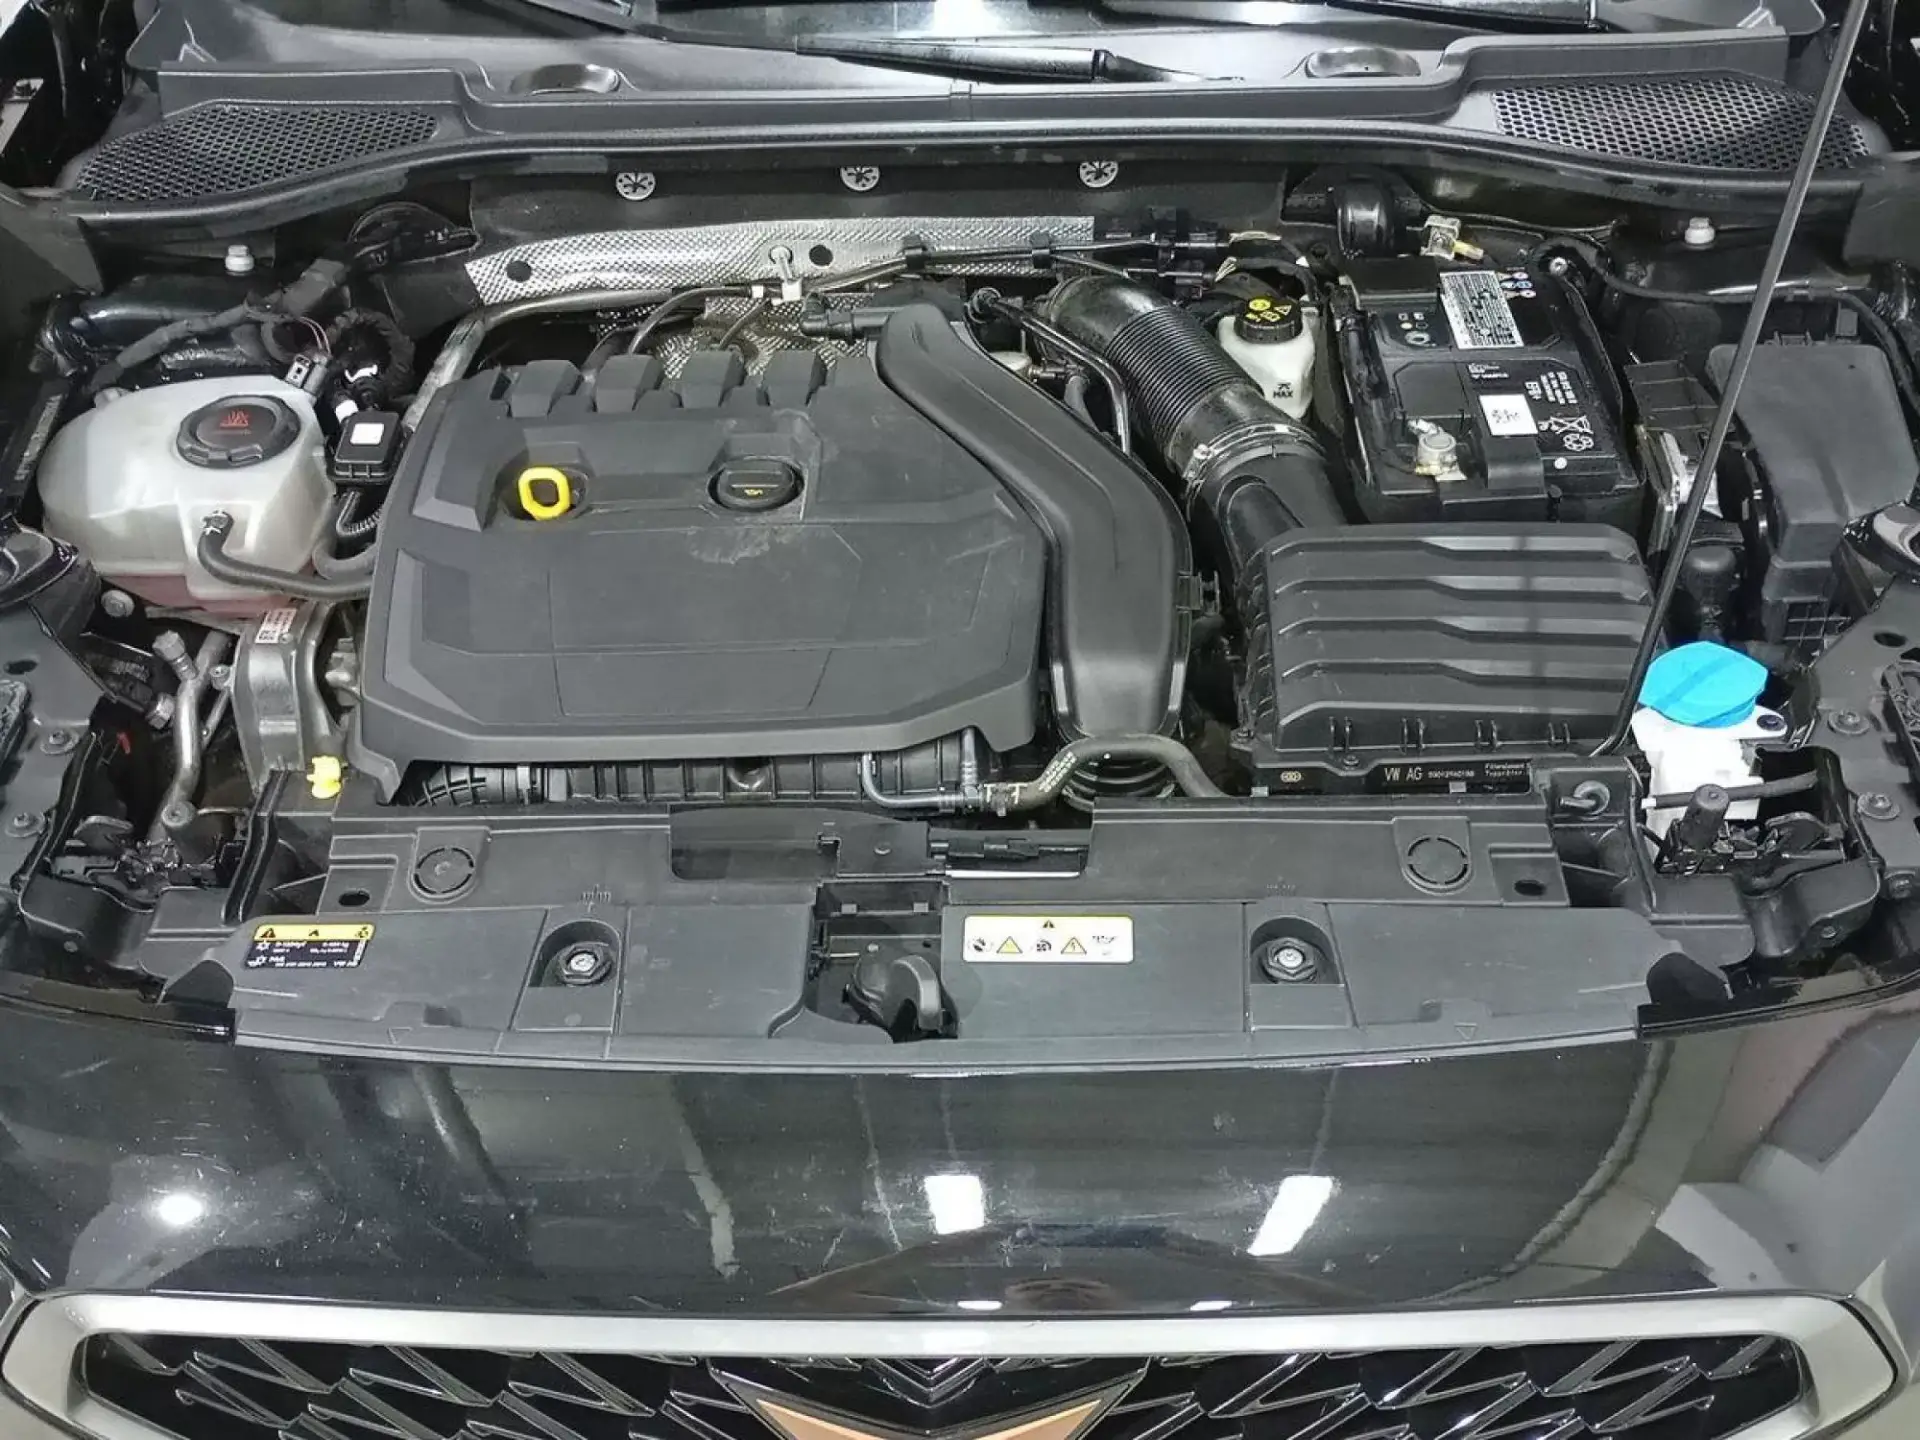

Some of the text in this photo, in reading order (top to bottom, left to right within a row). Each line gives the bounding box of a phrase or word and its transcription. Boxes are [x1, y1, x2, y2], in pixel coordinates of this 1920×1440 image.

[1273, 390, 1293, 398] MAX
[1384, 767, 1400, 781] VW
[1405, 766, 1422, 781] AG
